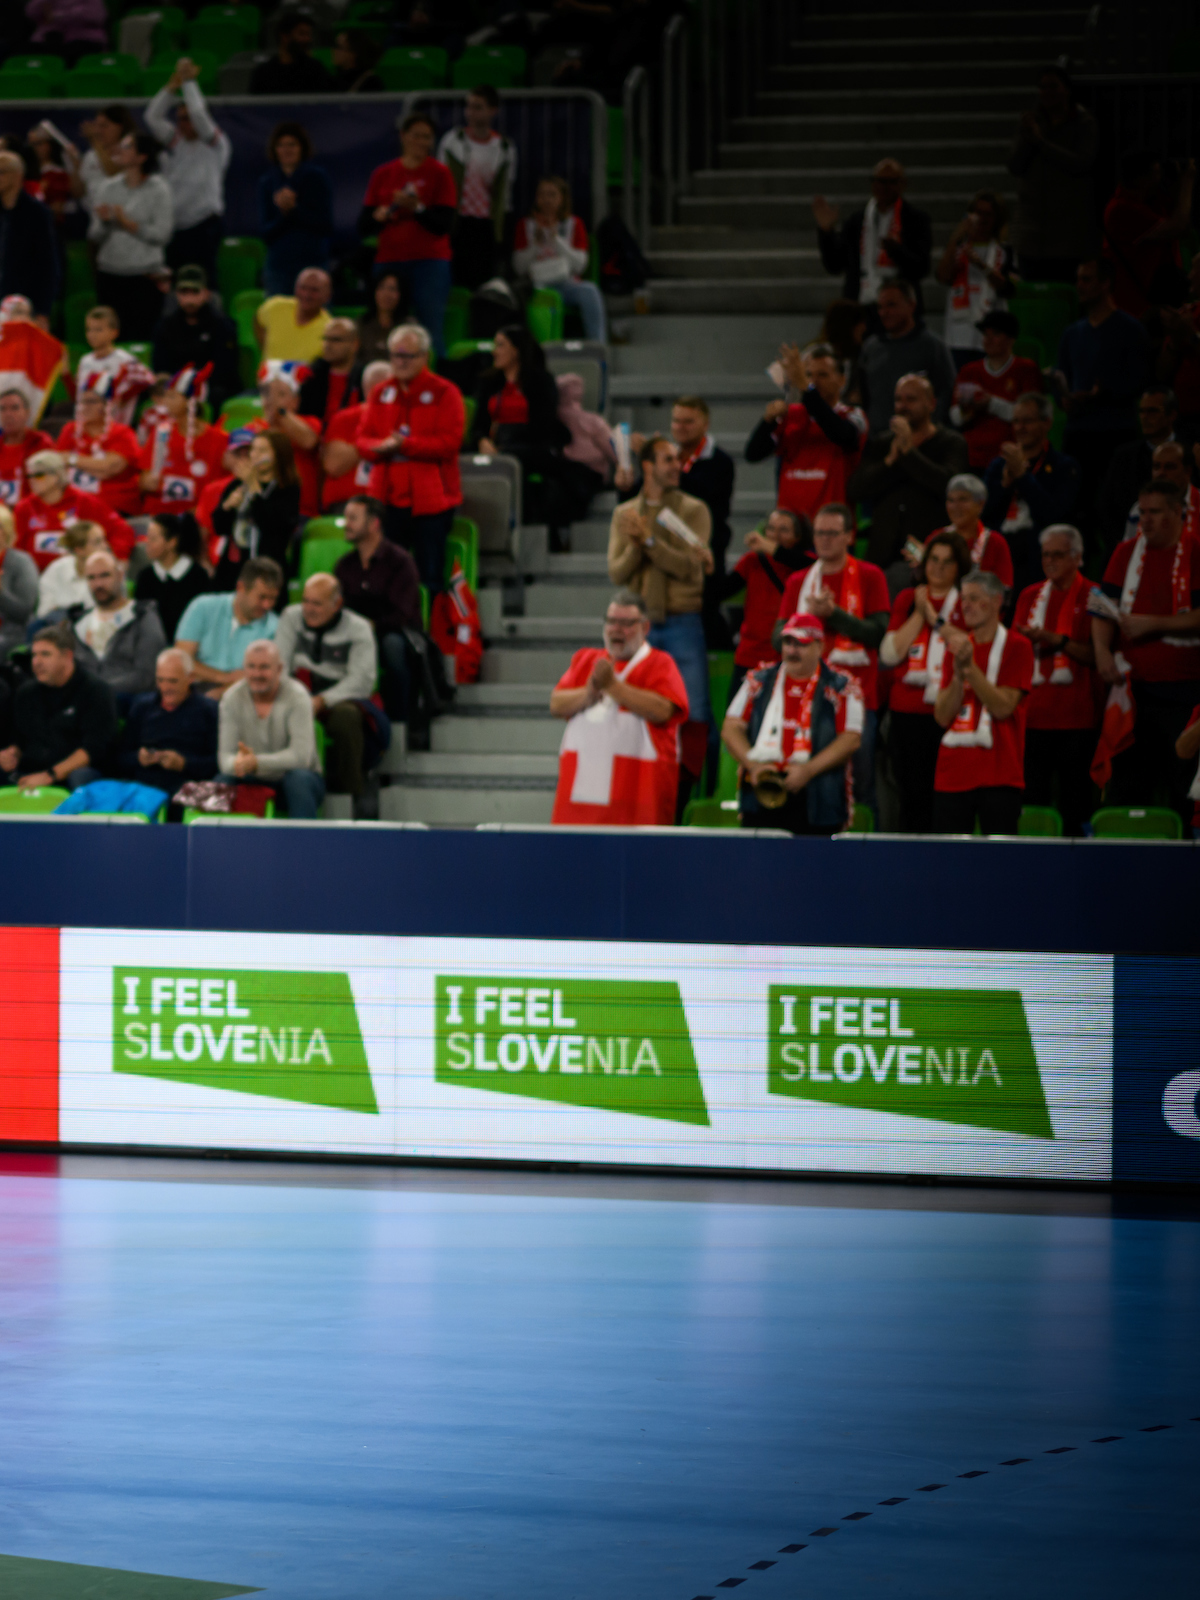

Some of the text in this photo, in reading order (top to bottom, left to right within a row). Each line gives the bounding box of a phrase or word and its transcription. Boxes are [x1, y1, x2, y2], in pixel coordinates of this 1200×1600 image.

[123, 977, 250, 1017] I FEEL
[445, 986, 576, 1027] I FEEL
[779, 995, 914, 1037] I FEEL
[124, 1023, 332, 1064] SLOVENIA
[446, 1032, 662, 1076] SLOVENIA
[780, 1043, 1002, 1086] SLOVENIA
